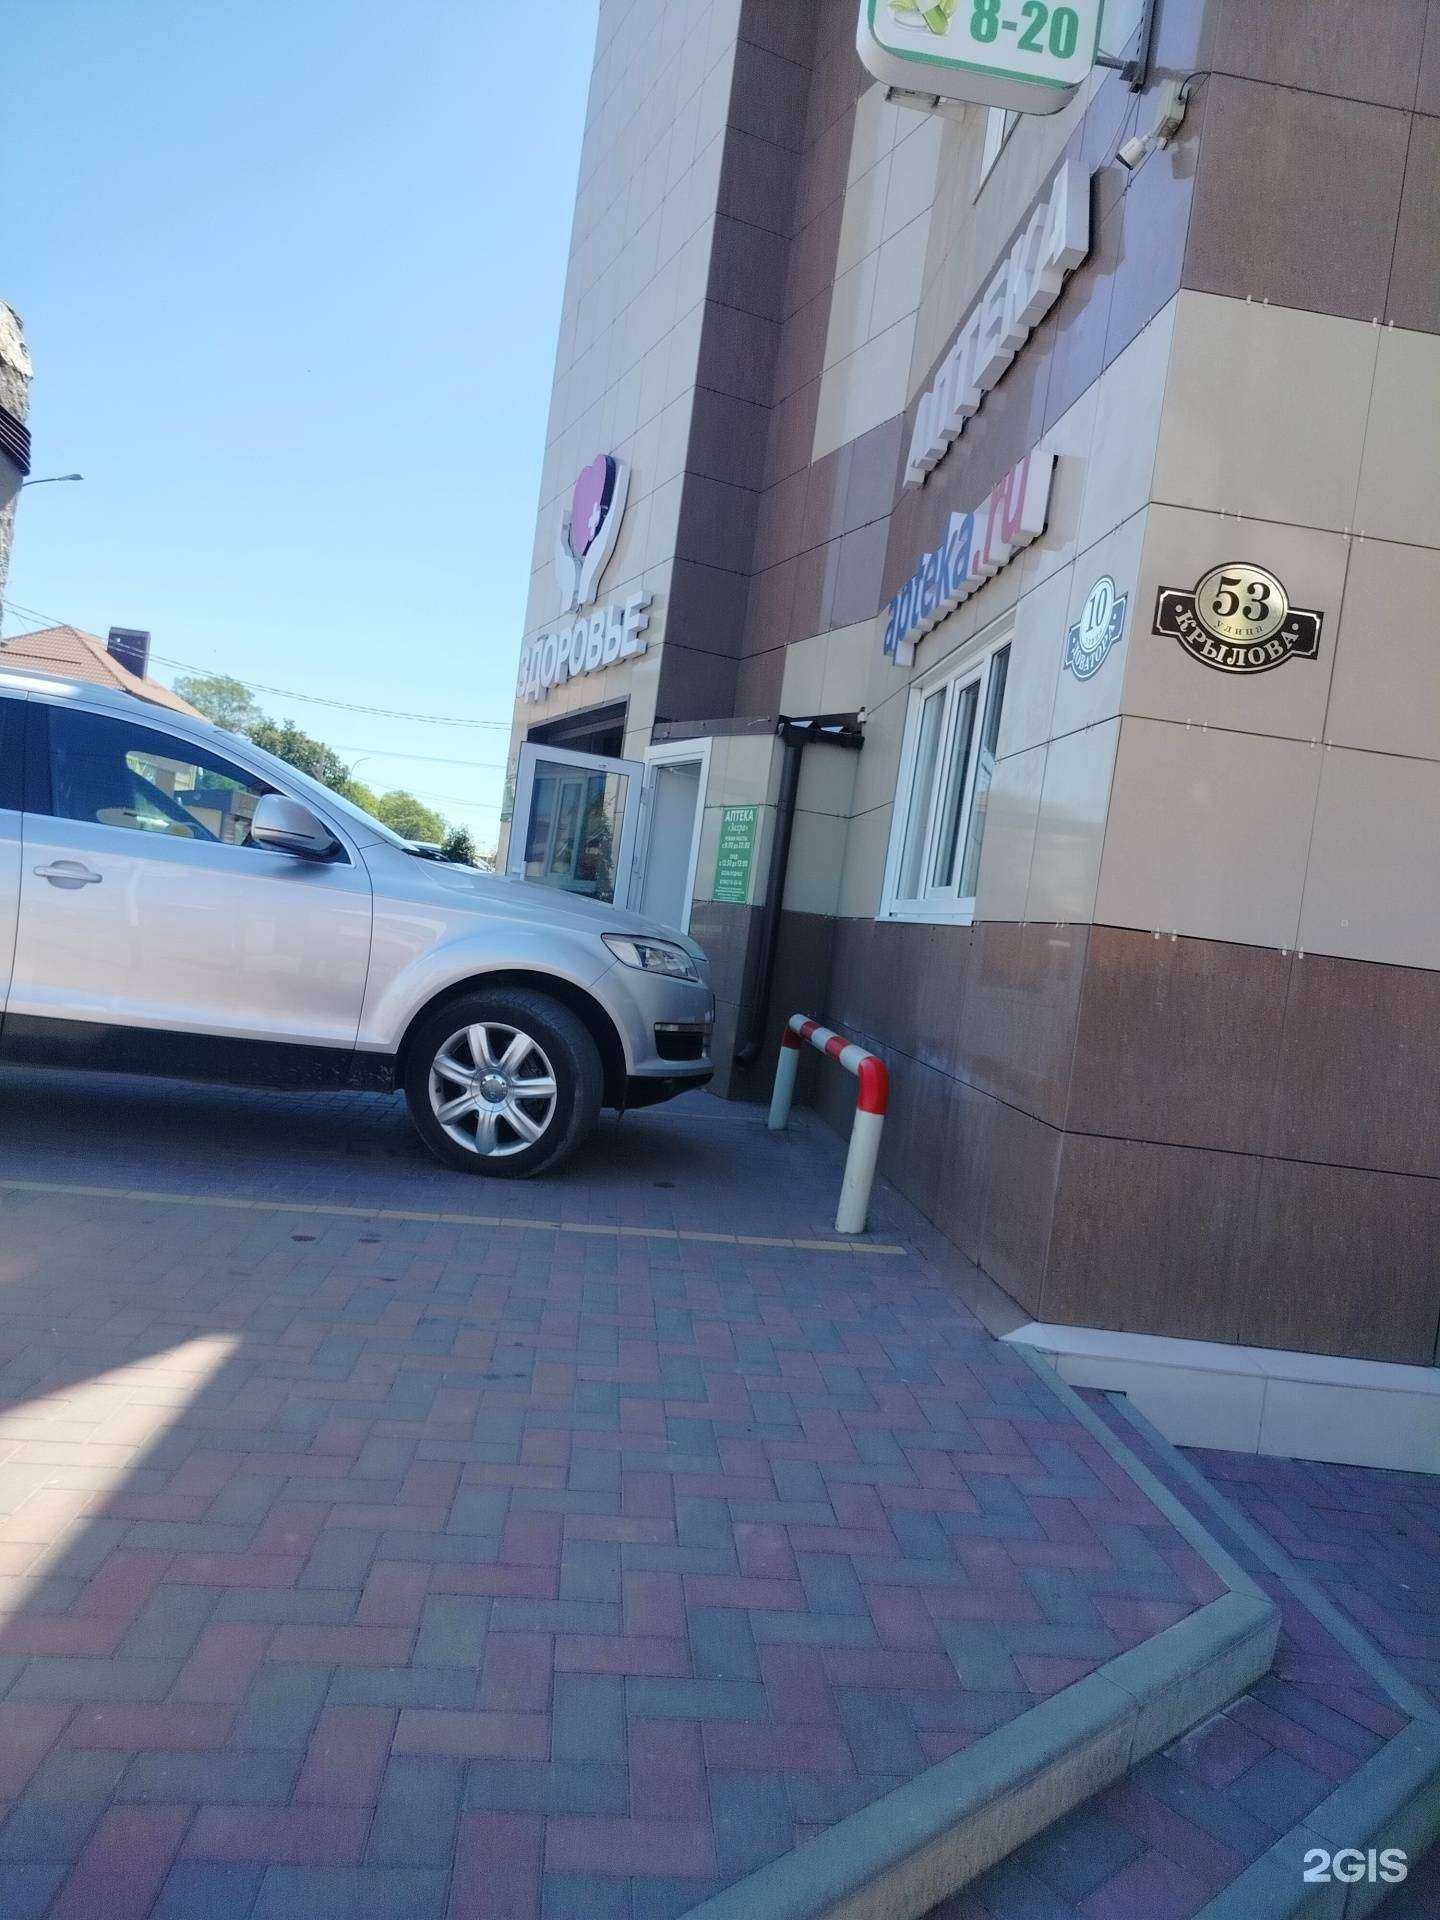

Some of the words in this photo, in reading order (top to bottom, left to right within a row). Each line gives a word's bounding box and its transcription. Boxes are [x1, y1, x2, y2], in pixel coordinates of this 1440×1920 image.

[970, 0, 1079, 59] 8-20
[1086, 587, 1107, 633] 10
[1212, 576, 1271, 621] 53
[517, 590, 652, 704] ЗДОРОВЬЕ
[1175, 609, 1299, 666] КРЫЛОВА
[725, 809, 754, 822] АПТЕКА
